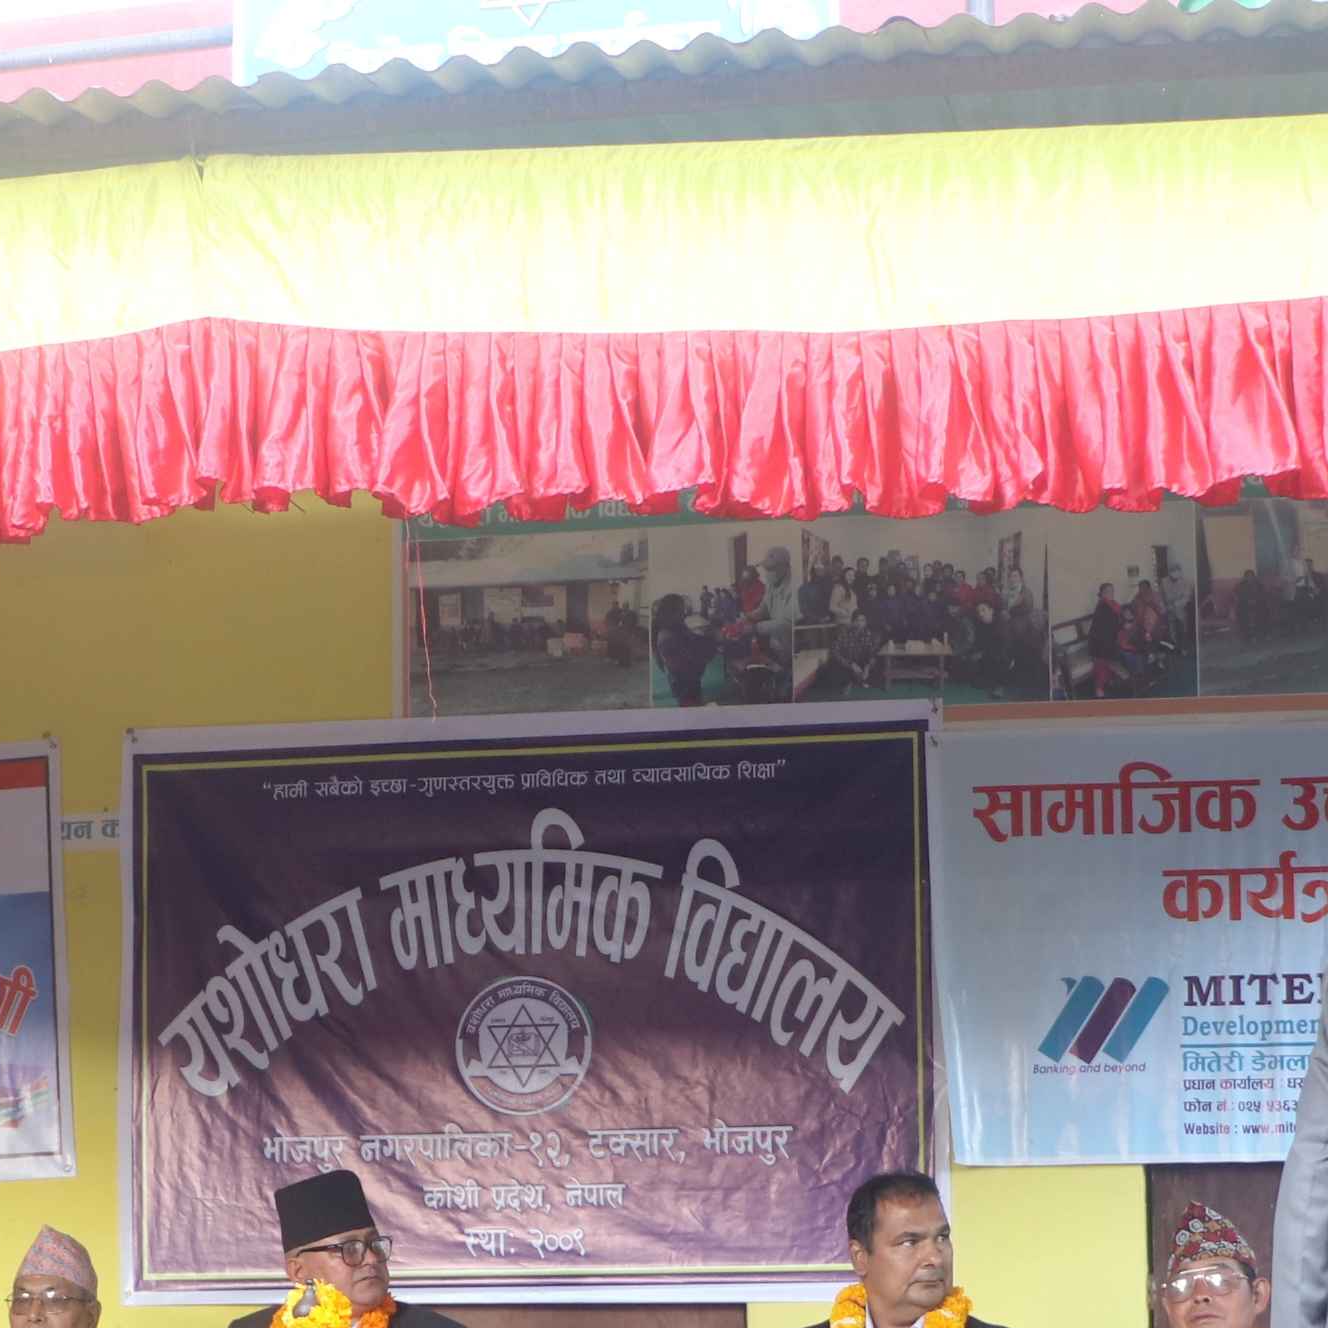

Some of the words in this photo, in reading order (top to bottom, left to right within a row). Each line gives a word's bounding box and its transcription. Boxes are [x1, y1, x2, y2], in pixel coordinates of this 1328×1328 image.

[315, 775, 363, 797] सबैको
[521, 768, 588, 790] प्राविधिक
[594, 768, 626, 786] तथा
[632, 762, 732, 784] व्यावसायिक
[971, 761, 1262, 843] सामाजिक
[158, 887, 376, 1099] यशोधरा
[379, 807, 664, 972] माध्यमिक
[662, 837, 907, 1095] विद्यालय
[1182, 972, 1323, 1007] MITE
[1032, 1062, 1076, 1076] Banking
[1078, 1062, 1102, 1074] and
[1104, 1061, 1147, 1076] beyond
[1183, 1049, 1244, 1073] मितेरी
[1250, 1049, 1309, 1072] डेभल
[1182, 1078, 1217, 1092] प्रधान
[1219, 1075, 1275, 1091] कार्यालय
[1183, 1097, 1213, 1113] फोन
[1183, 1122, 1231, 1136] Website
[1241, 1122, 1297, 1136] www.mit
[262, 1134, 347, 1174] भोजपुर
[702, 1122, 794, 1167] भोजपुर
[422, 1179, 480, 1210] कोशी
[564, 1178, 626, 1208] नेपाल
[530, 1228, 587, 1258] २००९
